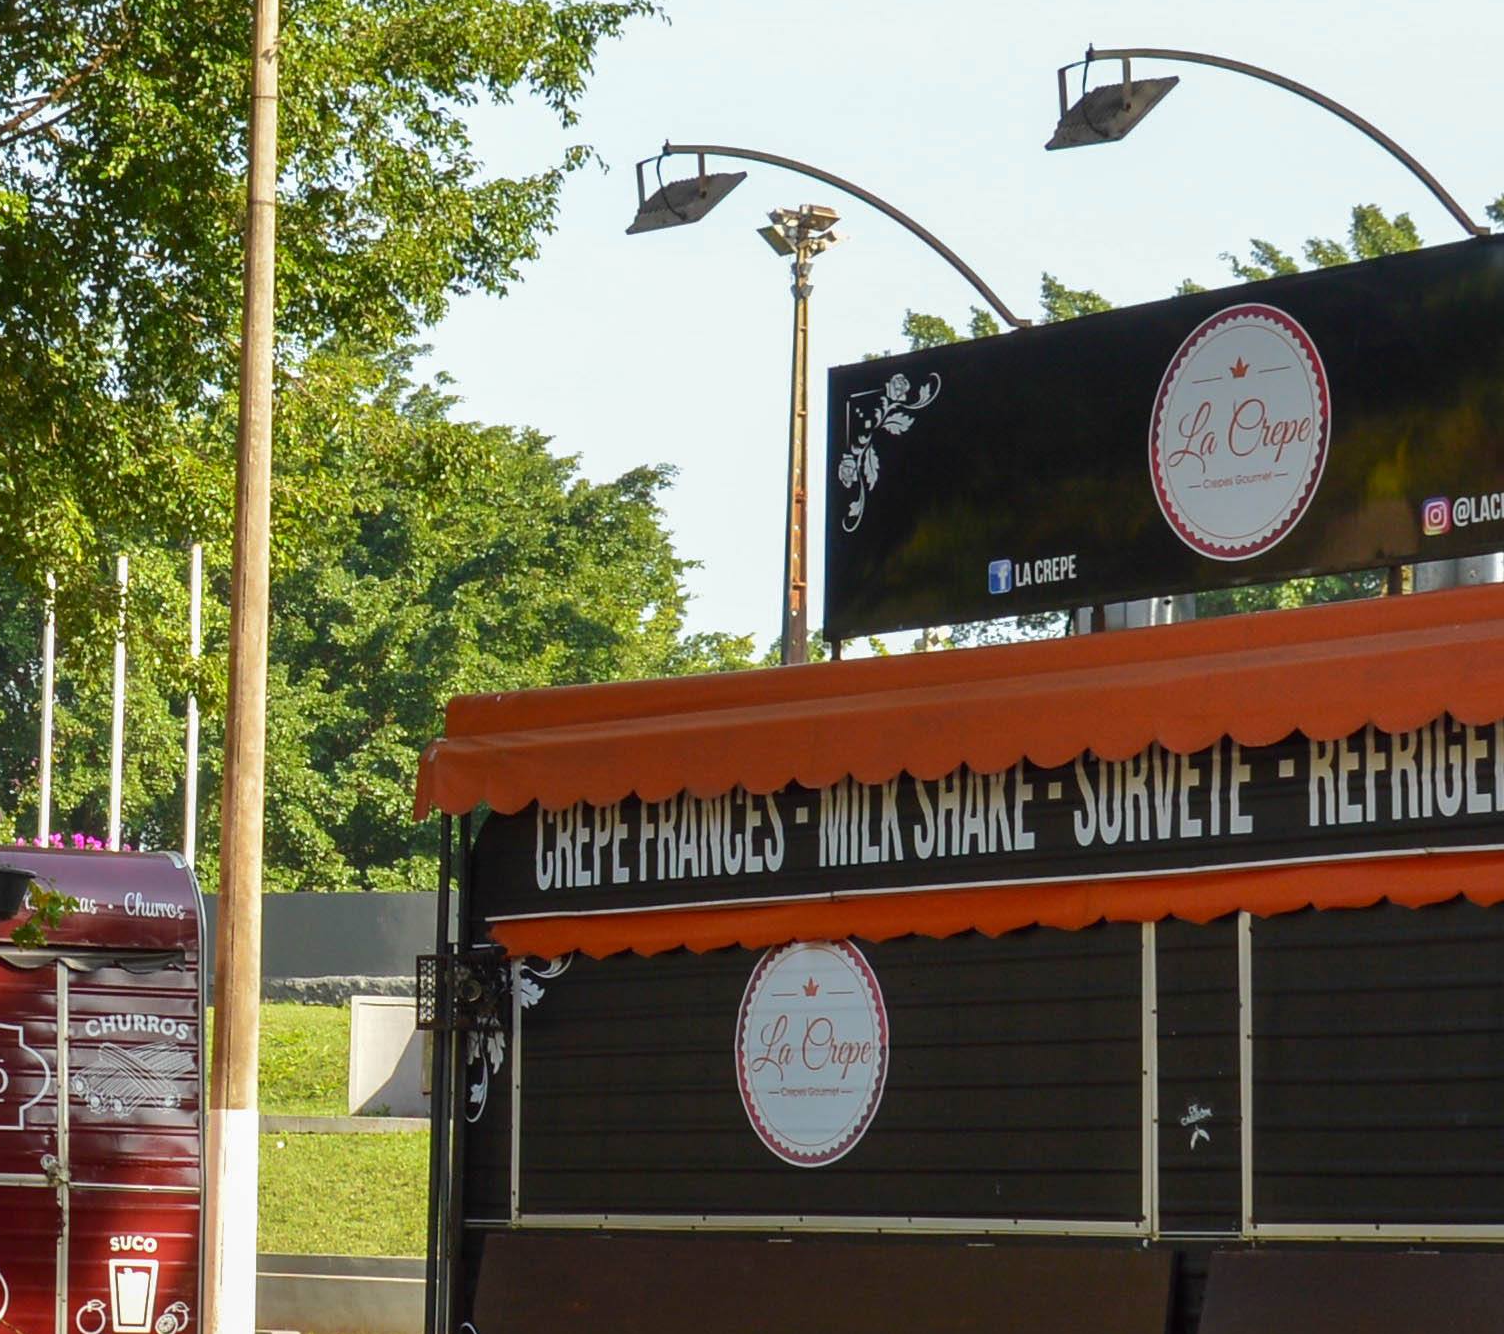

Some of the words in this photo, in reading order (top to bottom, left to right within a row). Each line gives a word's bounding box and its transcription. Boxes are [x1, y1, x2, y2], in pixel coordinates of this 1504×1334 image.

[1168, 401, 1217, 473] La
[1228, 398, 1312, 463] Crepe
[1015, 562, 1032, 587] LA
[1034, 554, 1078, 584] CREPE
[535, 799, 630, 891] CREPE
[819, 771, 905, 867] MILK
[913, 758, 1036, 860] SHAKE
[124, 892, 186, 920] Churros
[85, 1014, 190, 1041] CHURROS
[751, 1014, 792, 1081] La
[802, 1017, 873, 1079] Crepe
[109, 1235, 158, 1253] SUCO
